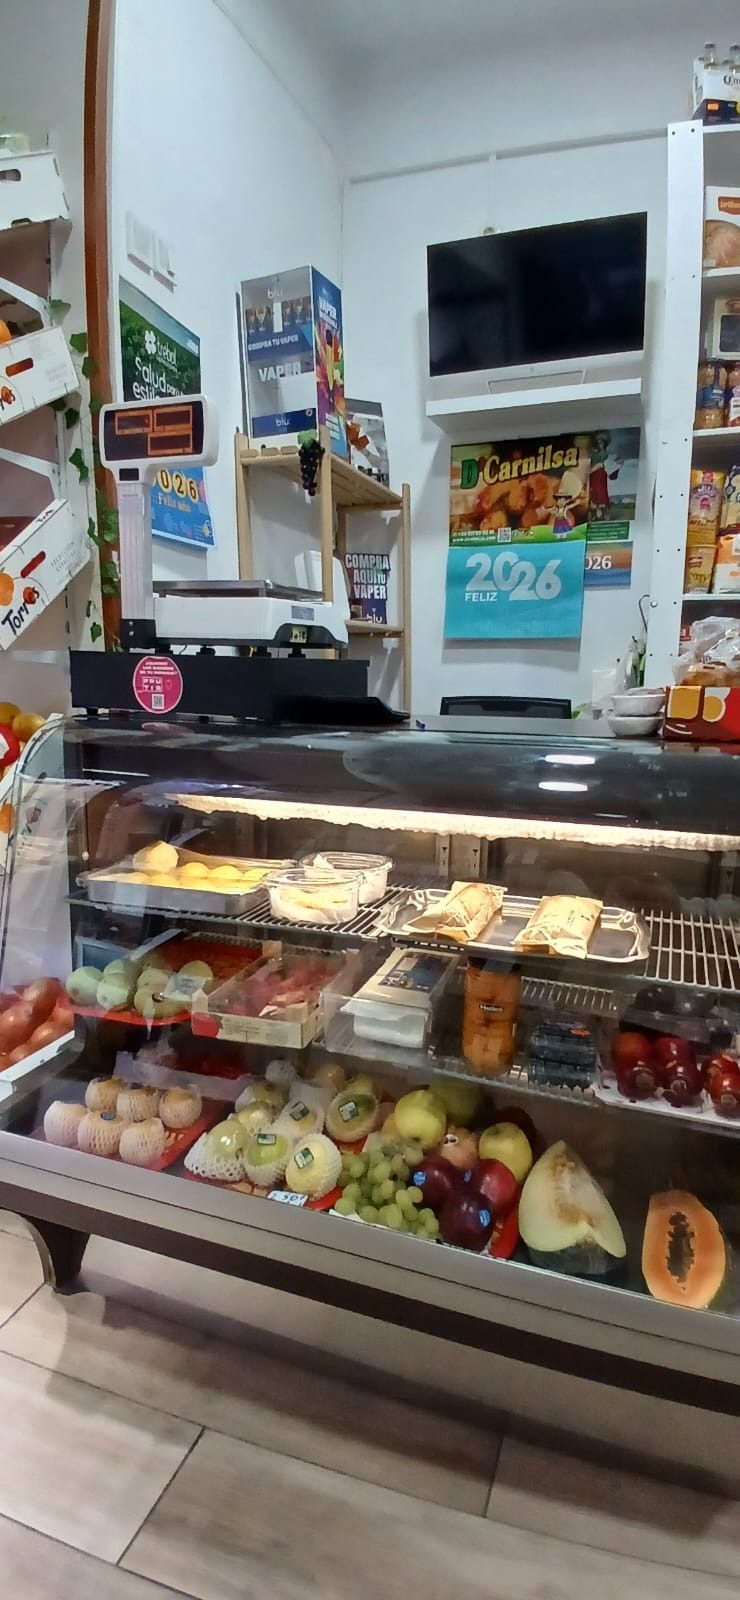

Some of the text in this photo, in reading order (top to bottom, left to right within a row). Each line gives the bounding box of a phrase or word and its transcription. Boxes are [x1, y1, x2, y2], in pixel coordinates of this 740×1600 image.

[247, 339, 273, 351] COMPRA
[135, 356, 167, 393] Salud
[258, 362, 302, 383] VAPER
[275, 416, 290, 427] blu
[345, 554, 389, 569] COMPRA
[377, 573, 387, 584] TU
[465, 551, 562, 601] 2026
[354, 585, 387, 600] VAPER
[465, 592, 498, 602] FELIZ
